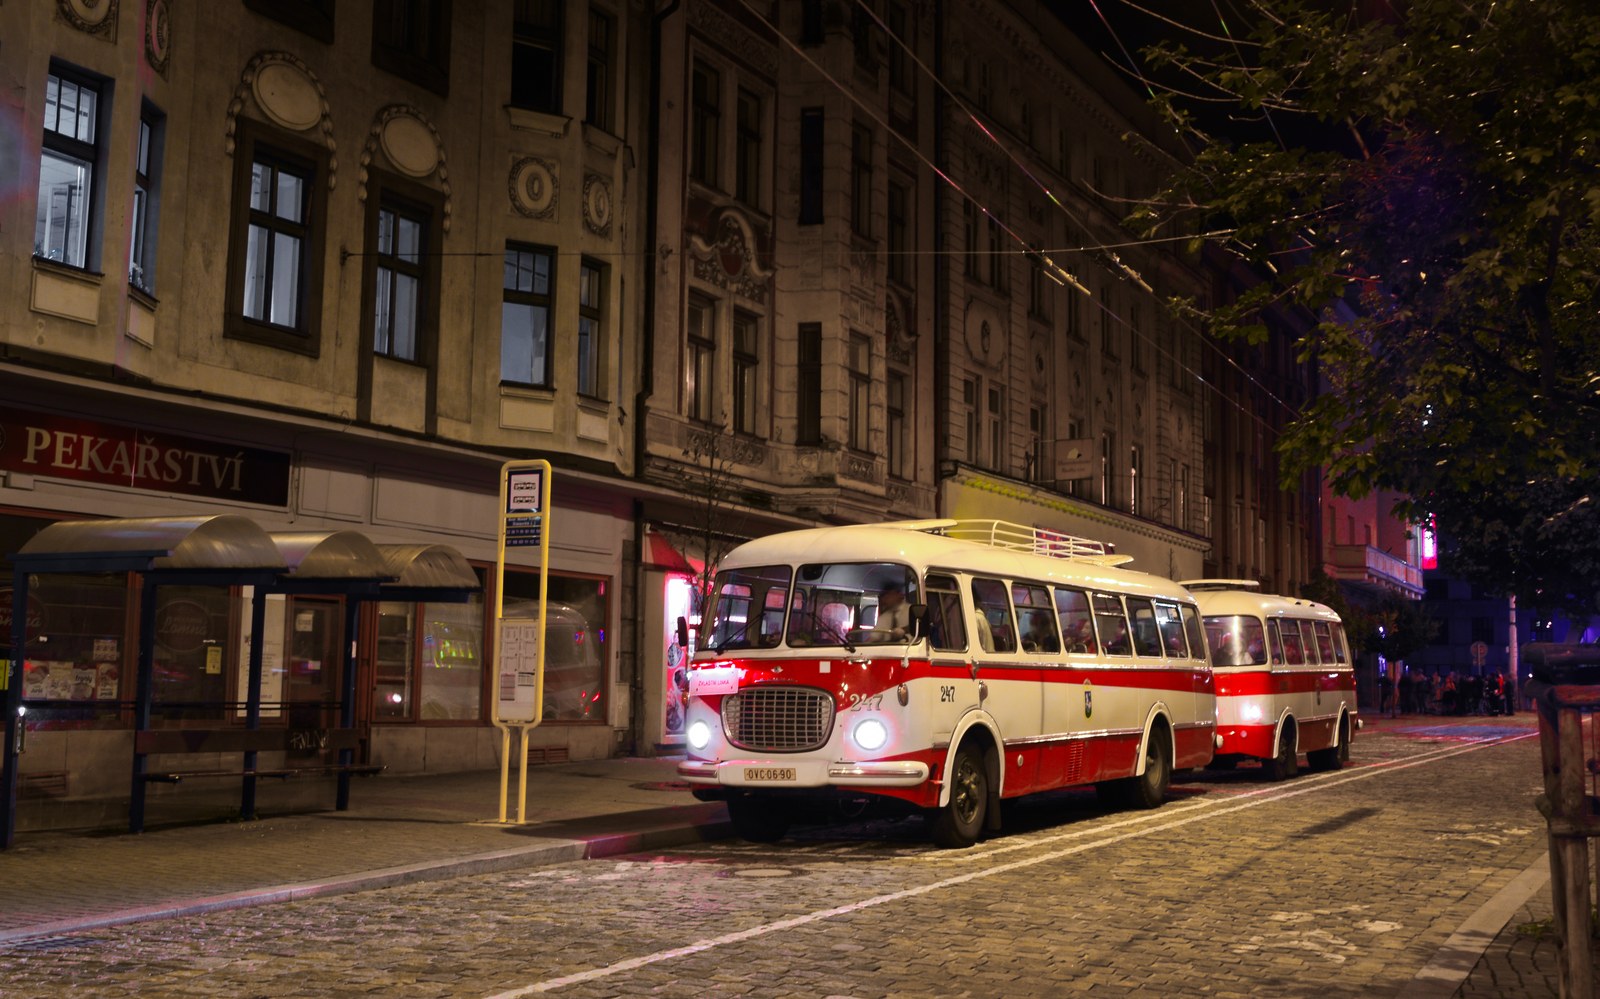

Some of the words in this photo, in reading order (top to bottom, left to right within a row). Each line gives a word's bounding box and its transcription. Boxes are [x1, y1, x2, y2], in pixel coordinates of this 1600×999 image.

[23, 426, 245, 491] PEKAŘSTVÍ
[850, 694, 884, 712] 247
[940, 686, 956, 703] 247
